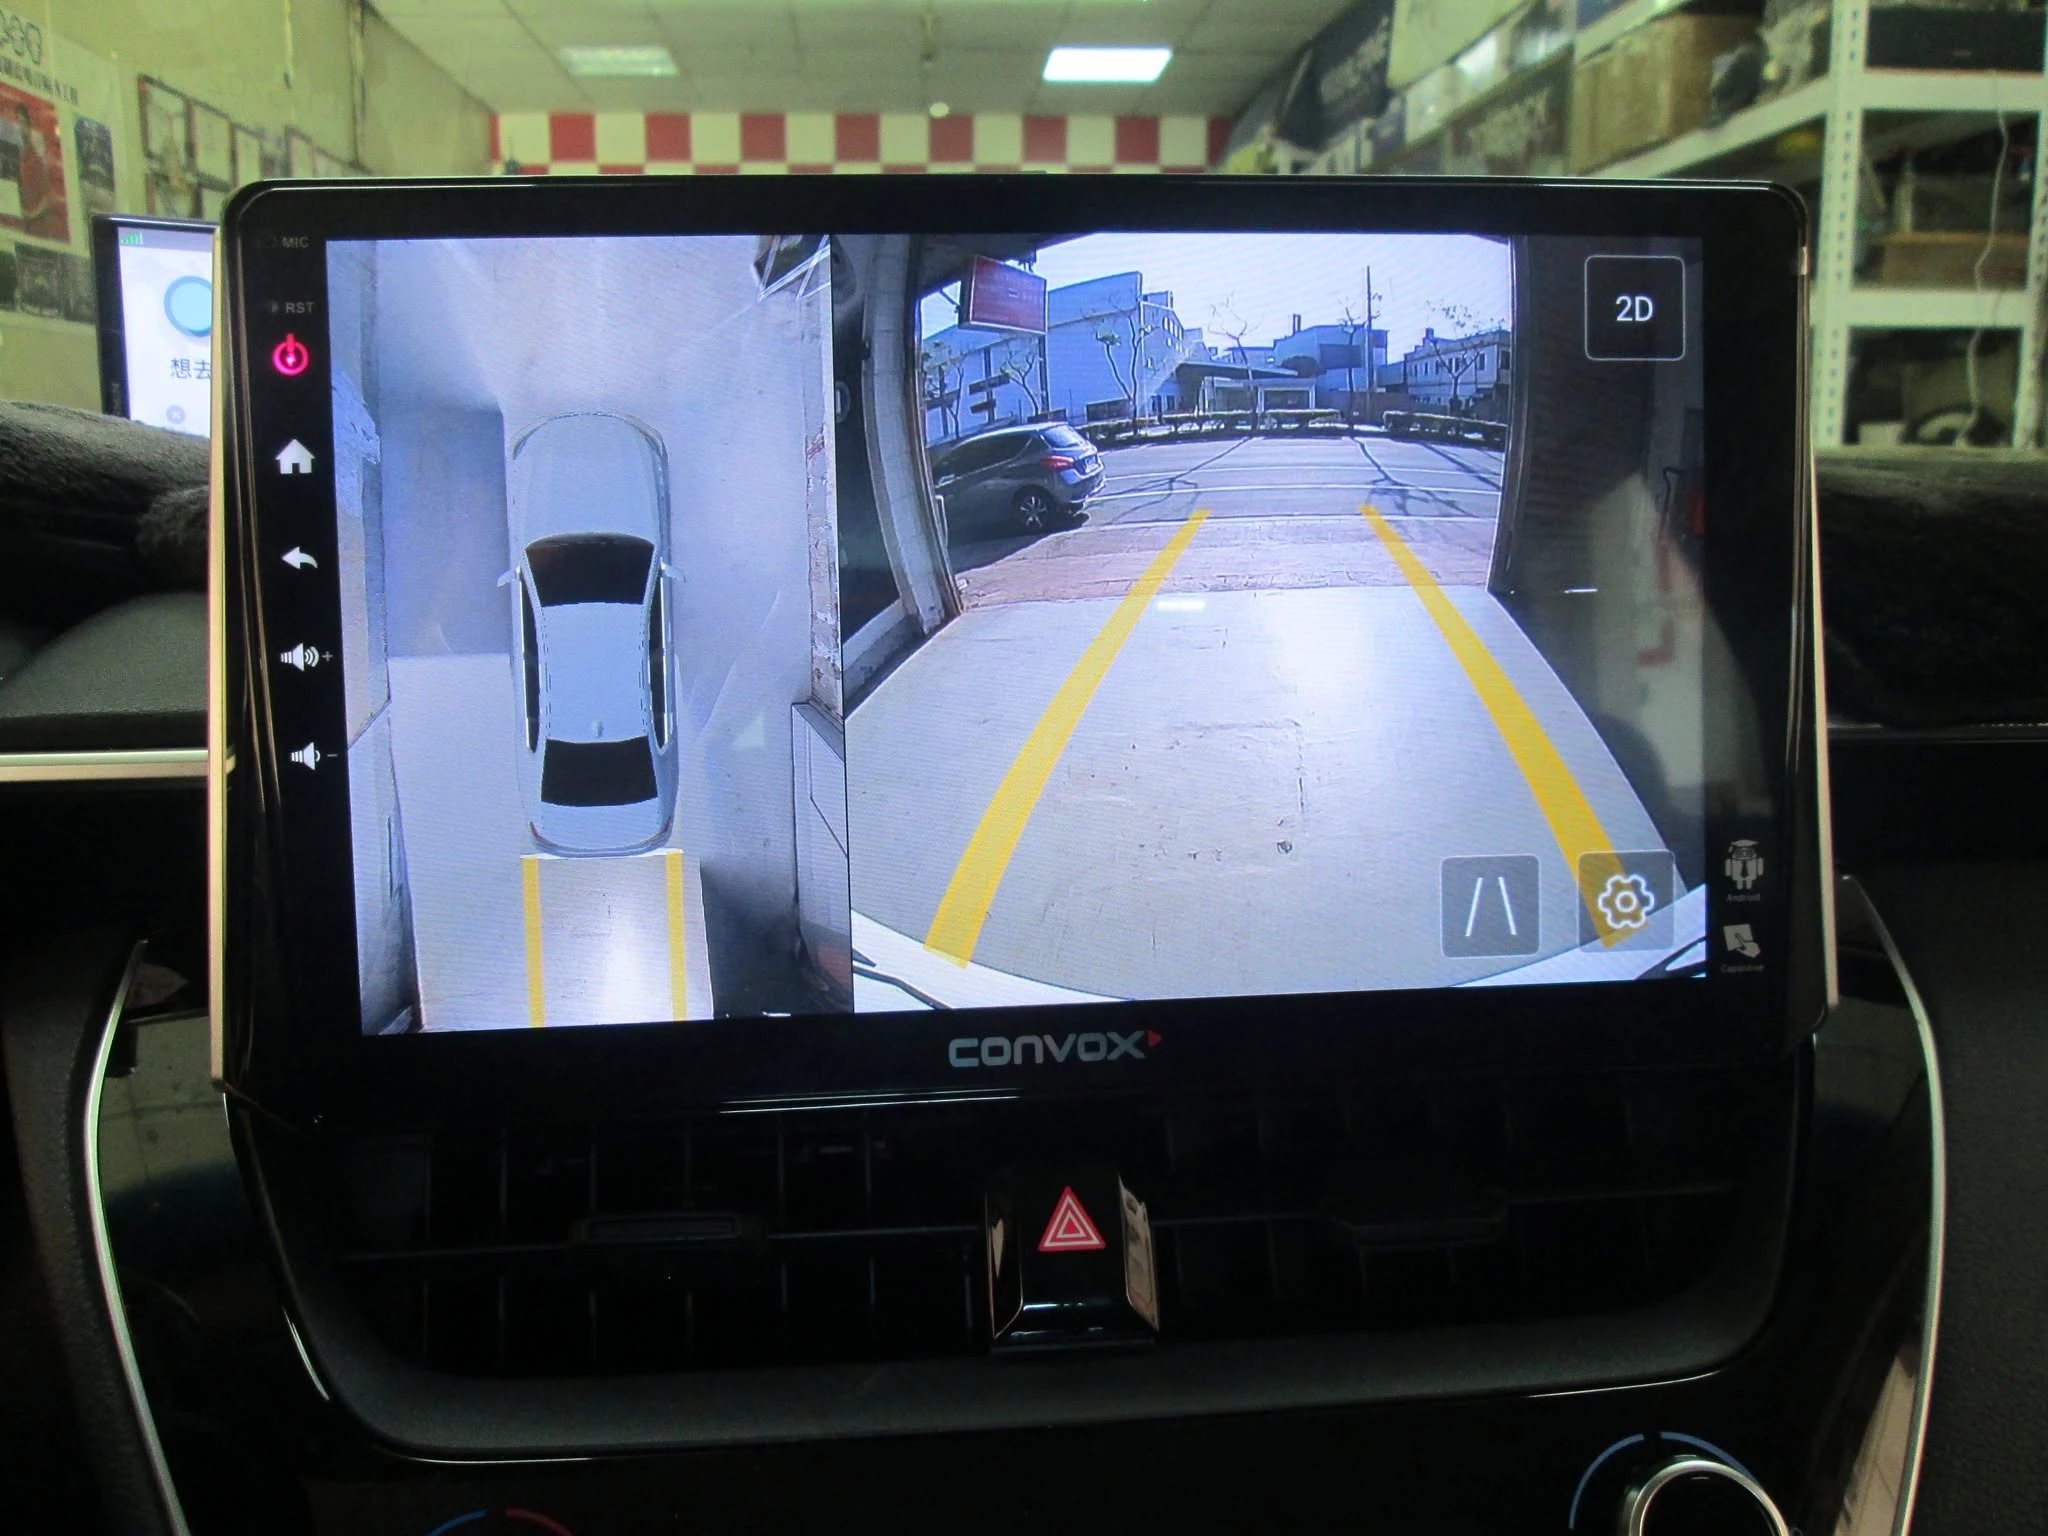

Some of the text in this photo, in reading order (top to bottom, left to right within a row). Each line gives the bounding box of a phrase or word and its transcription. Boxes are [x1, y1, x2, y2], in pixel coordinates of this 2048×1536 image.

[281, 235, 310, 249] MIC
[285, 301, 315, 314] RST
[1615, 294, 1655, 322] 2D
